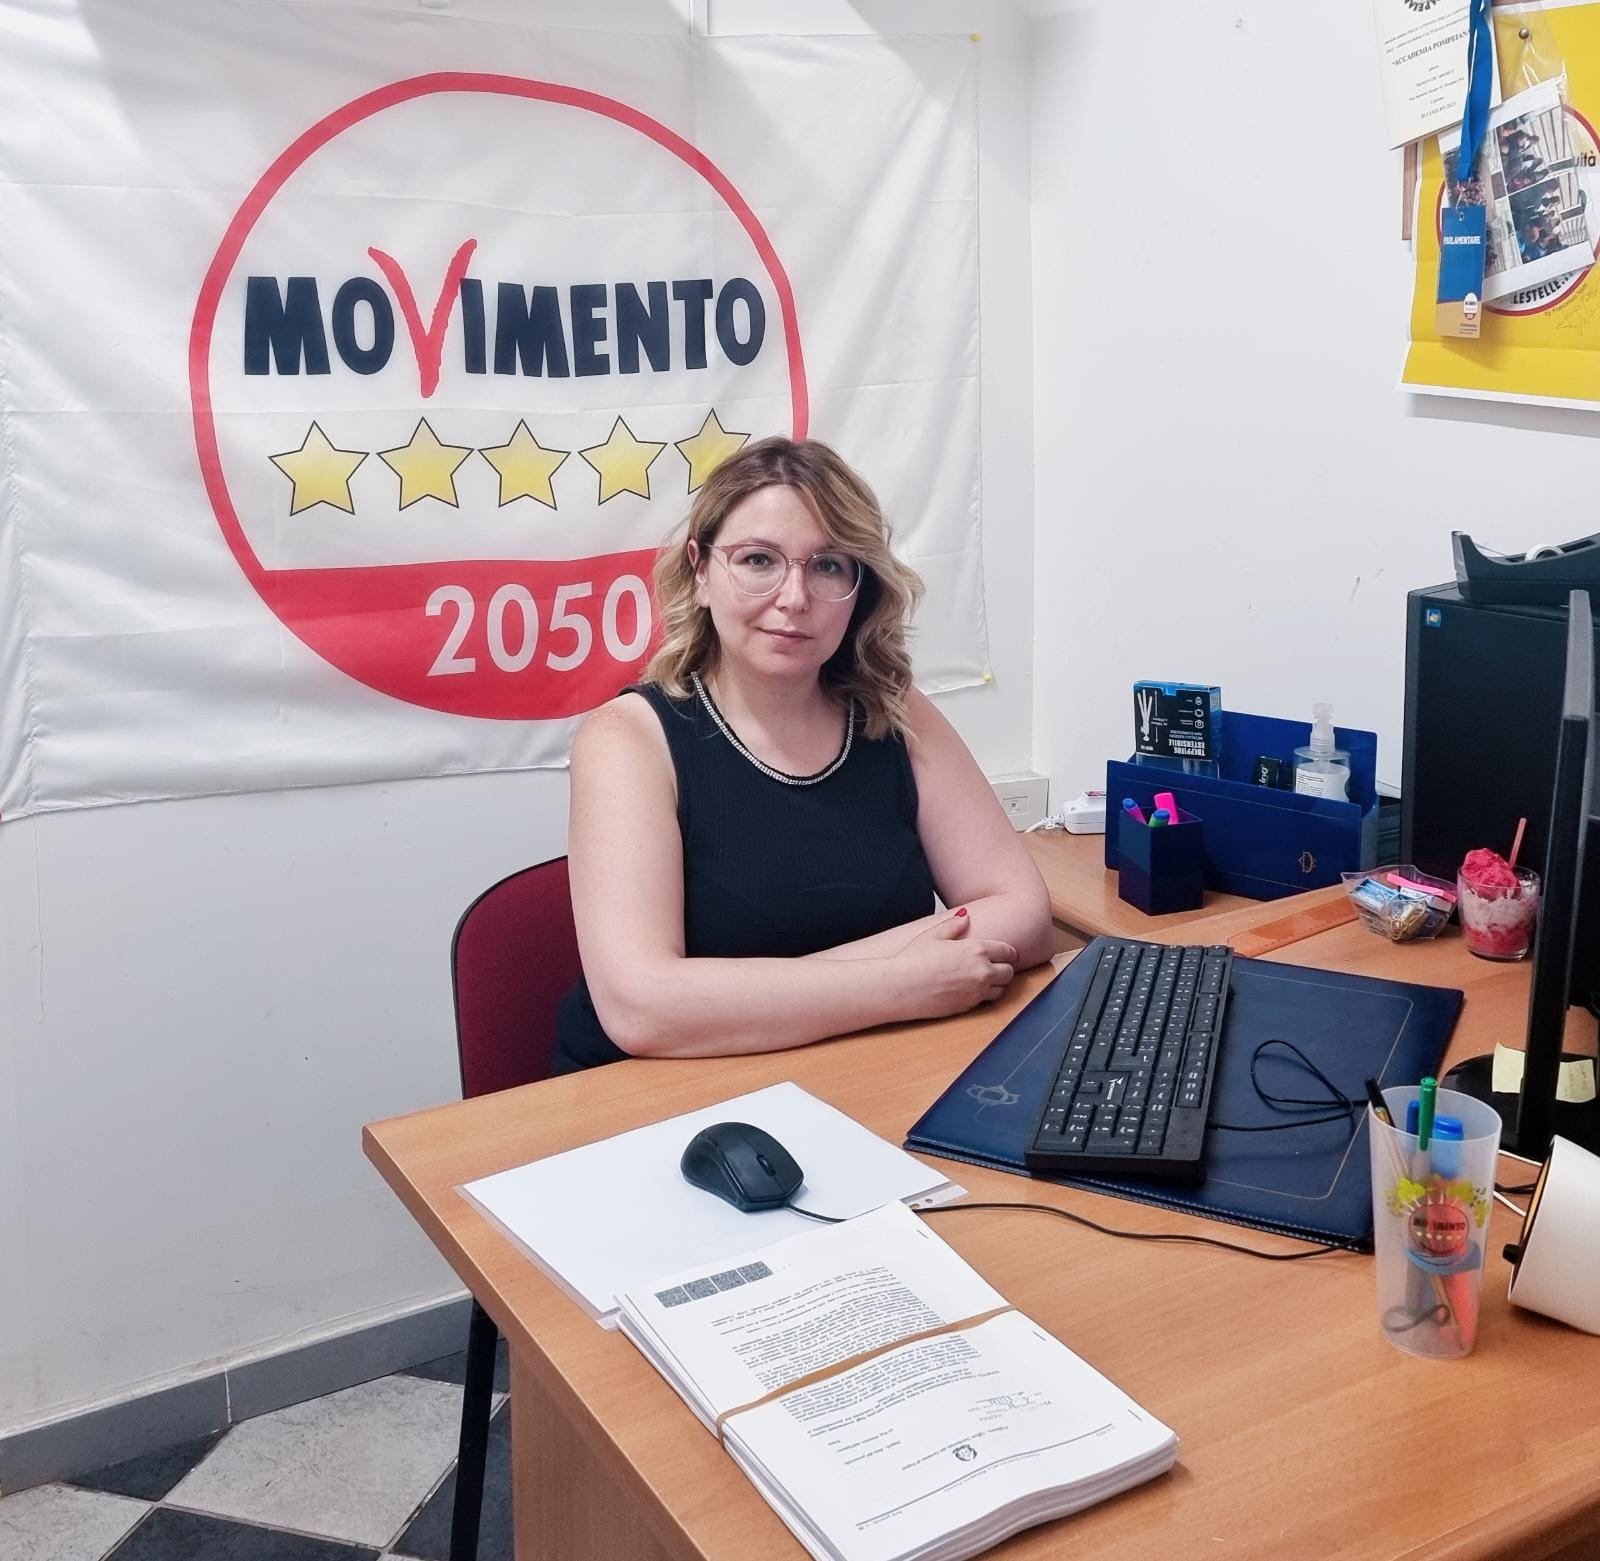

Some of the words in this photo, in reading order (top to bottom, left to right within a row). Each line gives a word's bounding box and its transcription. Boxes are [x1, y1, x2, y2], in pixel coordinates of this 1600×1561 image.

[1432, 31, 1471, 49] POMPEIAN
[244, 238, 766, 398] MOVIMENTO
[424, 574, 652, 677] 2050
